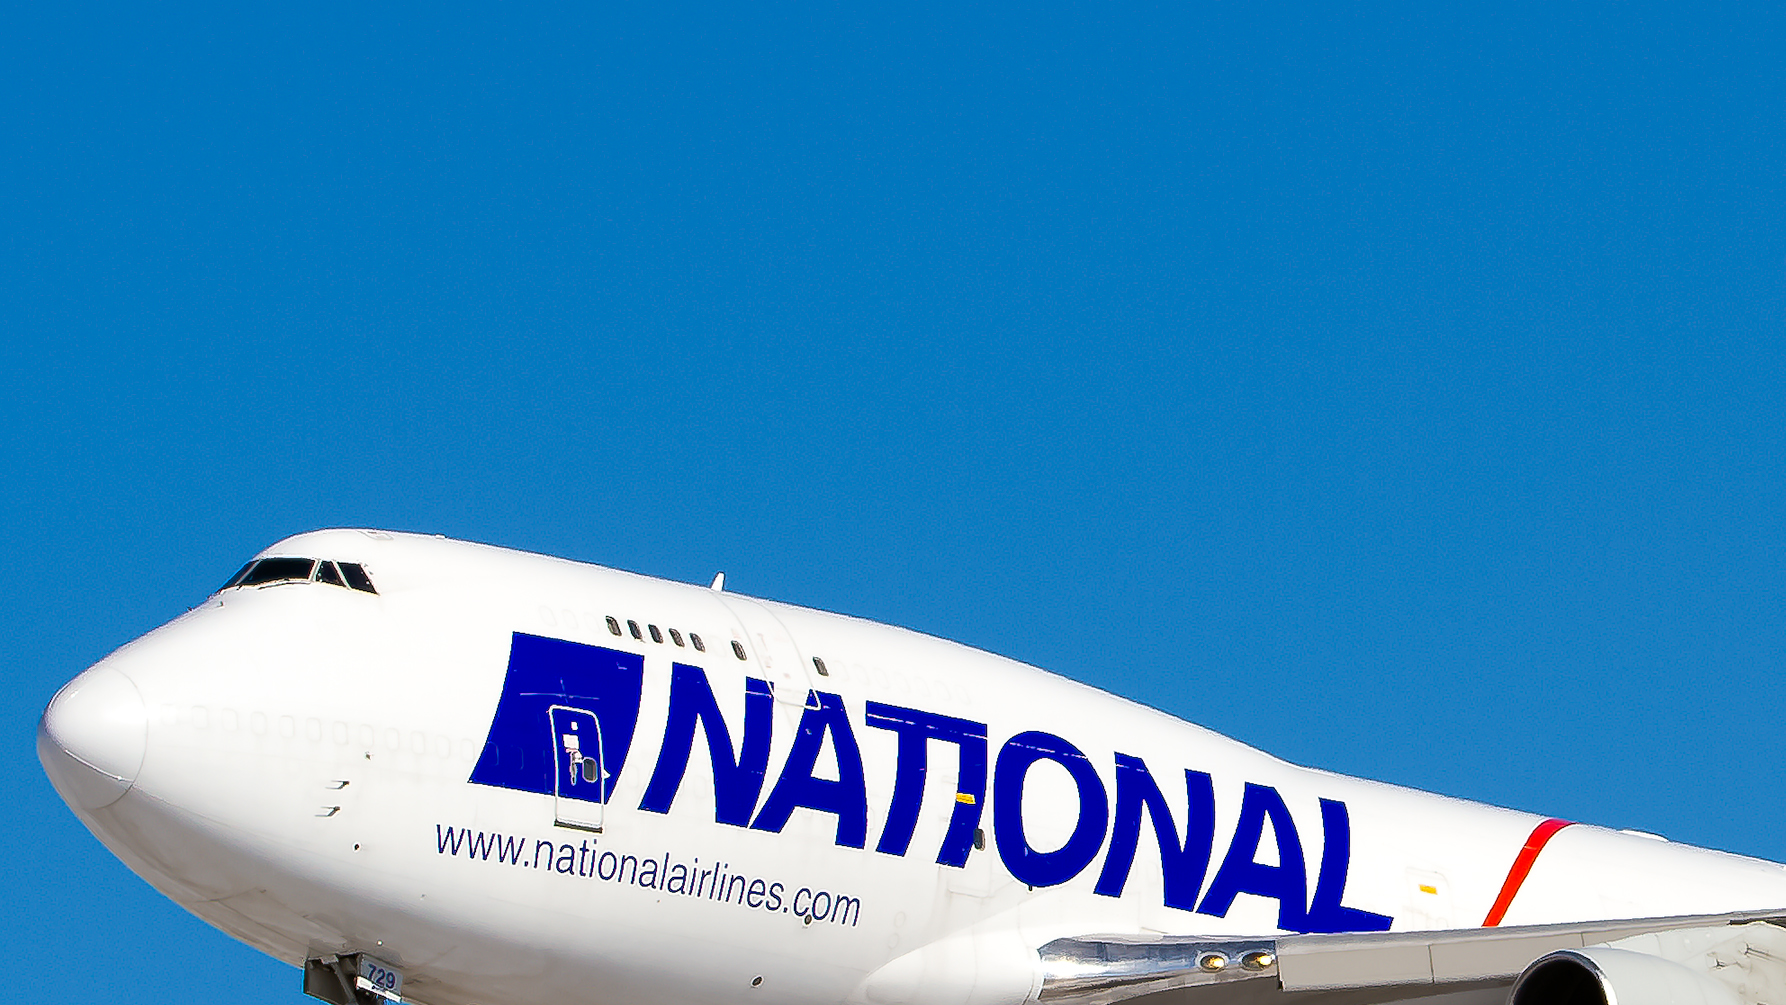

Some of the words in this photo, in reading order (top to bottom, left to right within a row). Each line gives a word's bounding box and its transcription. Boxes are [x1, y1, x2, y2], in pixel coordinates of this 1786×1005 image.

[638, 662, 1394, 934] NATIONAL
[436, 824, 862, 927] www.nationalairlines.com
[368, 963, 396, 989] 729
